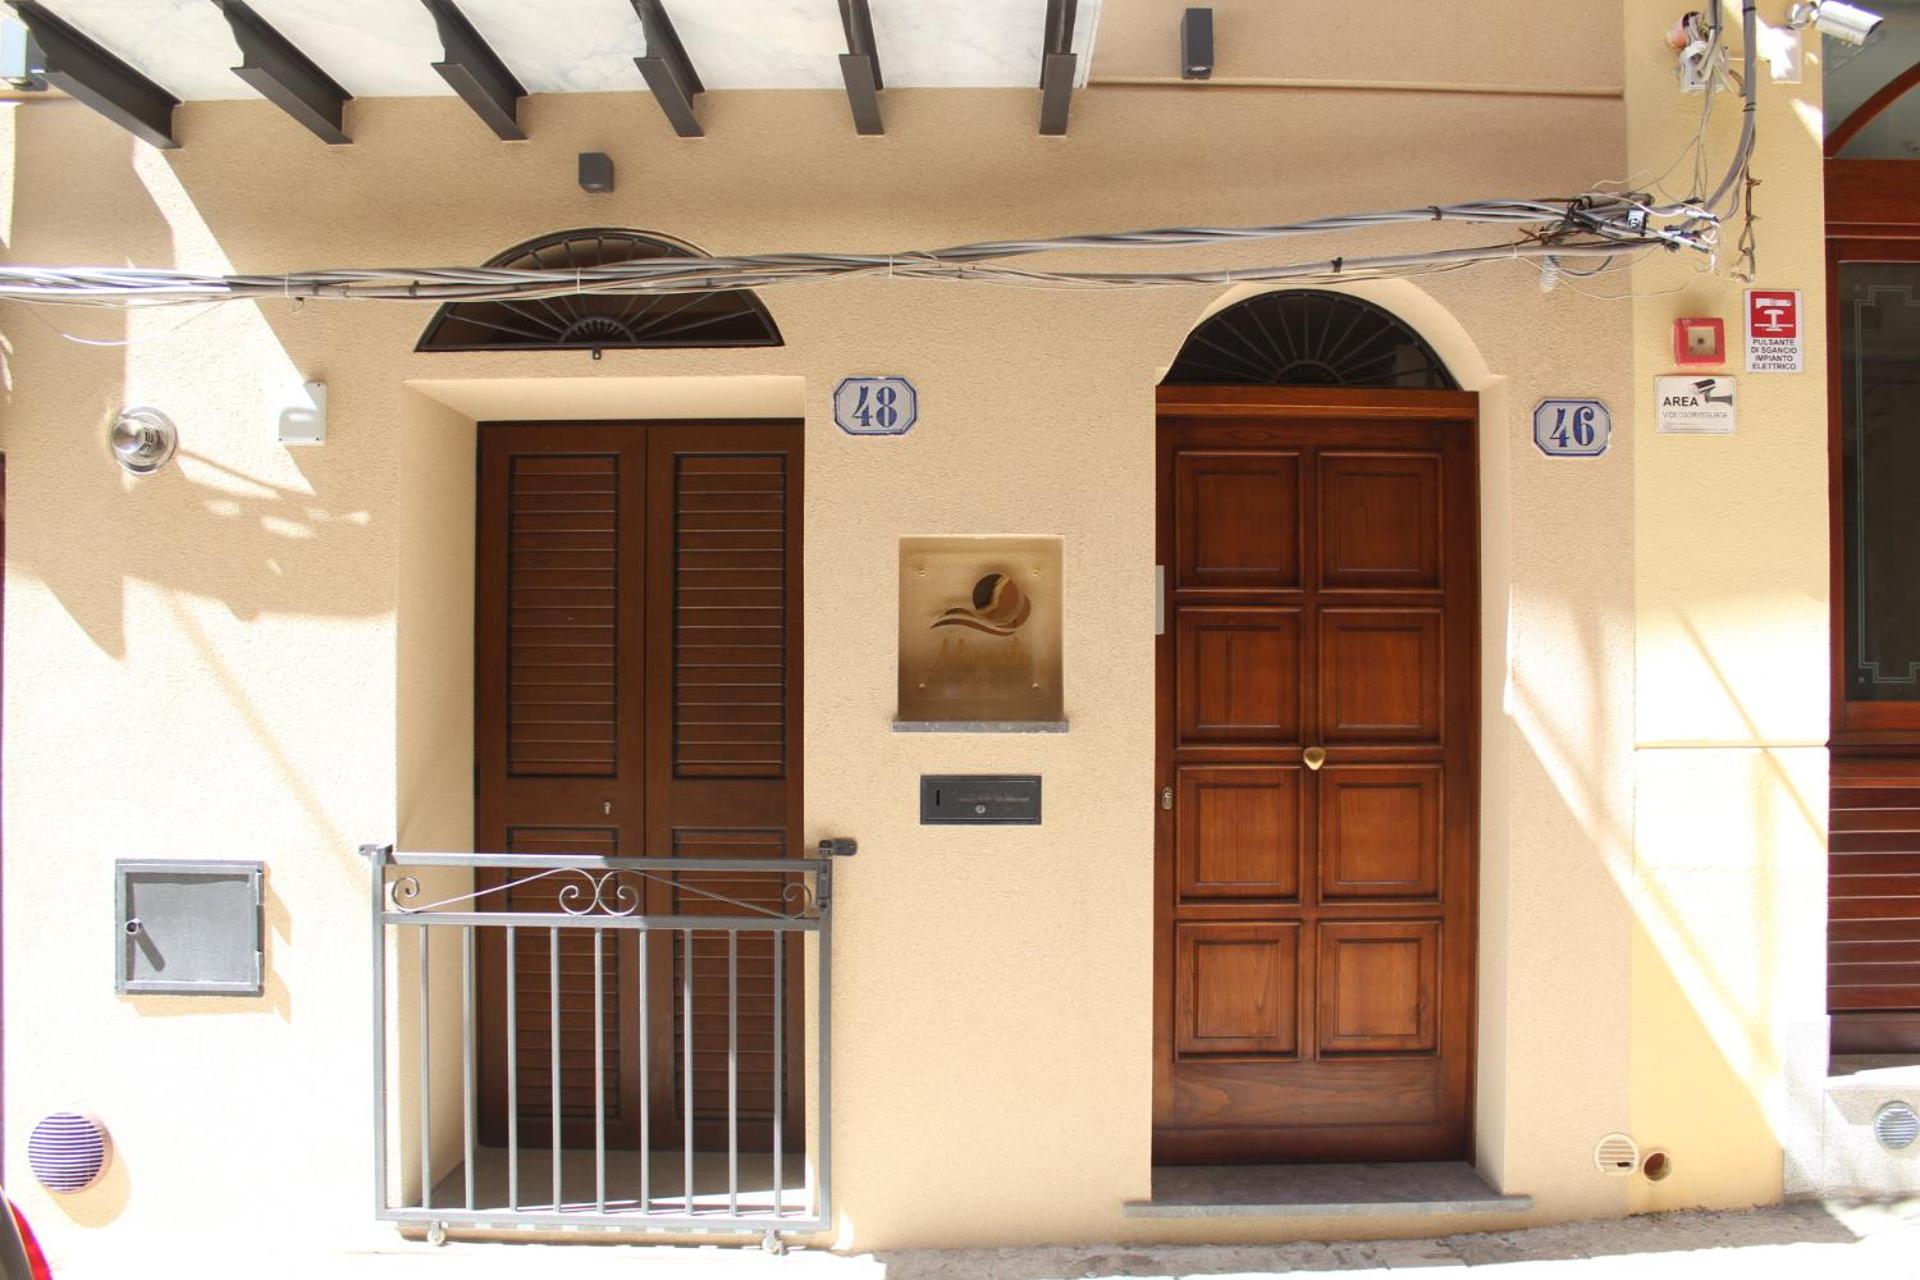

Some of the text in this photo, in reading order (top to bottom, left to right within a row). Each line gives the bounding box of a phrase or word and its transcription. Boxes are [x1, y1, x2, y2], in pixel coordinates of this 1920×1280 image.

[1750, 346, 1798, 354] DI SGANCIO
[852, 386, 897, 428] 48
[1663, 396, 1699, 407] AREA
[1549, 406, 1594, 448] 46
